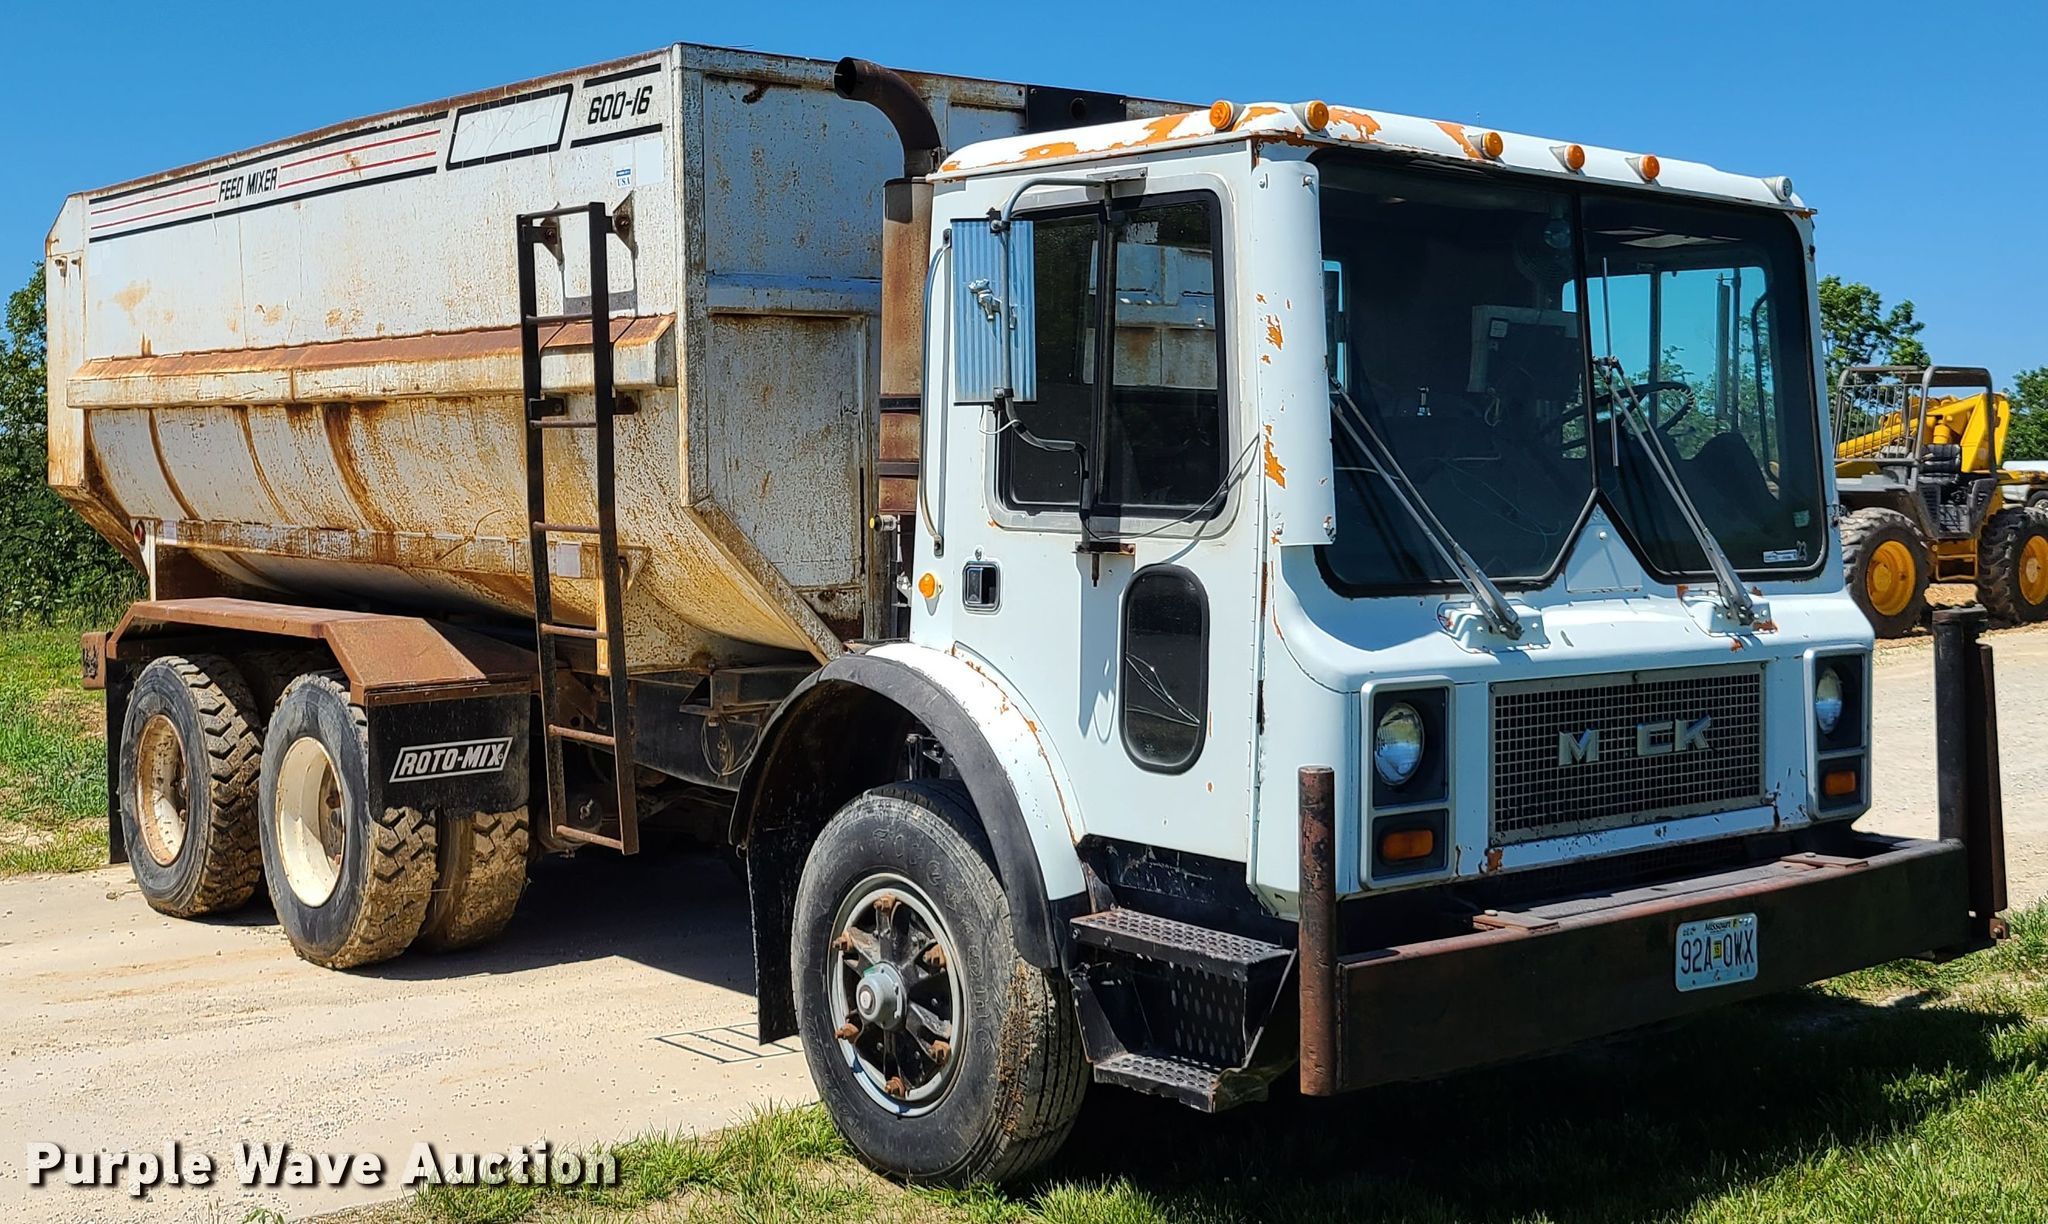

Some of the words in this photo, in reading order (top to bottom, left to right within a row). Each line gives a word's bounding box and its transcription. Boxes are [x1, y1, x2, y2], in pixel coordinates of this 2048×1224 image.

[588, 85, 653, 125] 600-16
[218, 176, 244, 202] FEED
[246, 167, 278, 197] MIXER
[399, 743, 504, 776] ROTO-MIX
